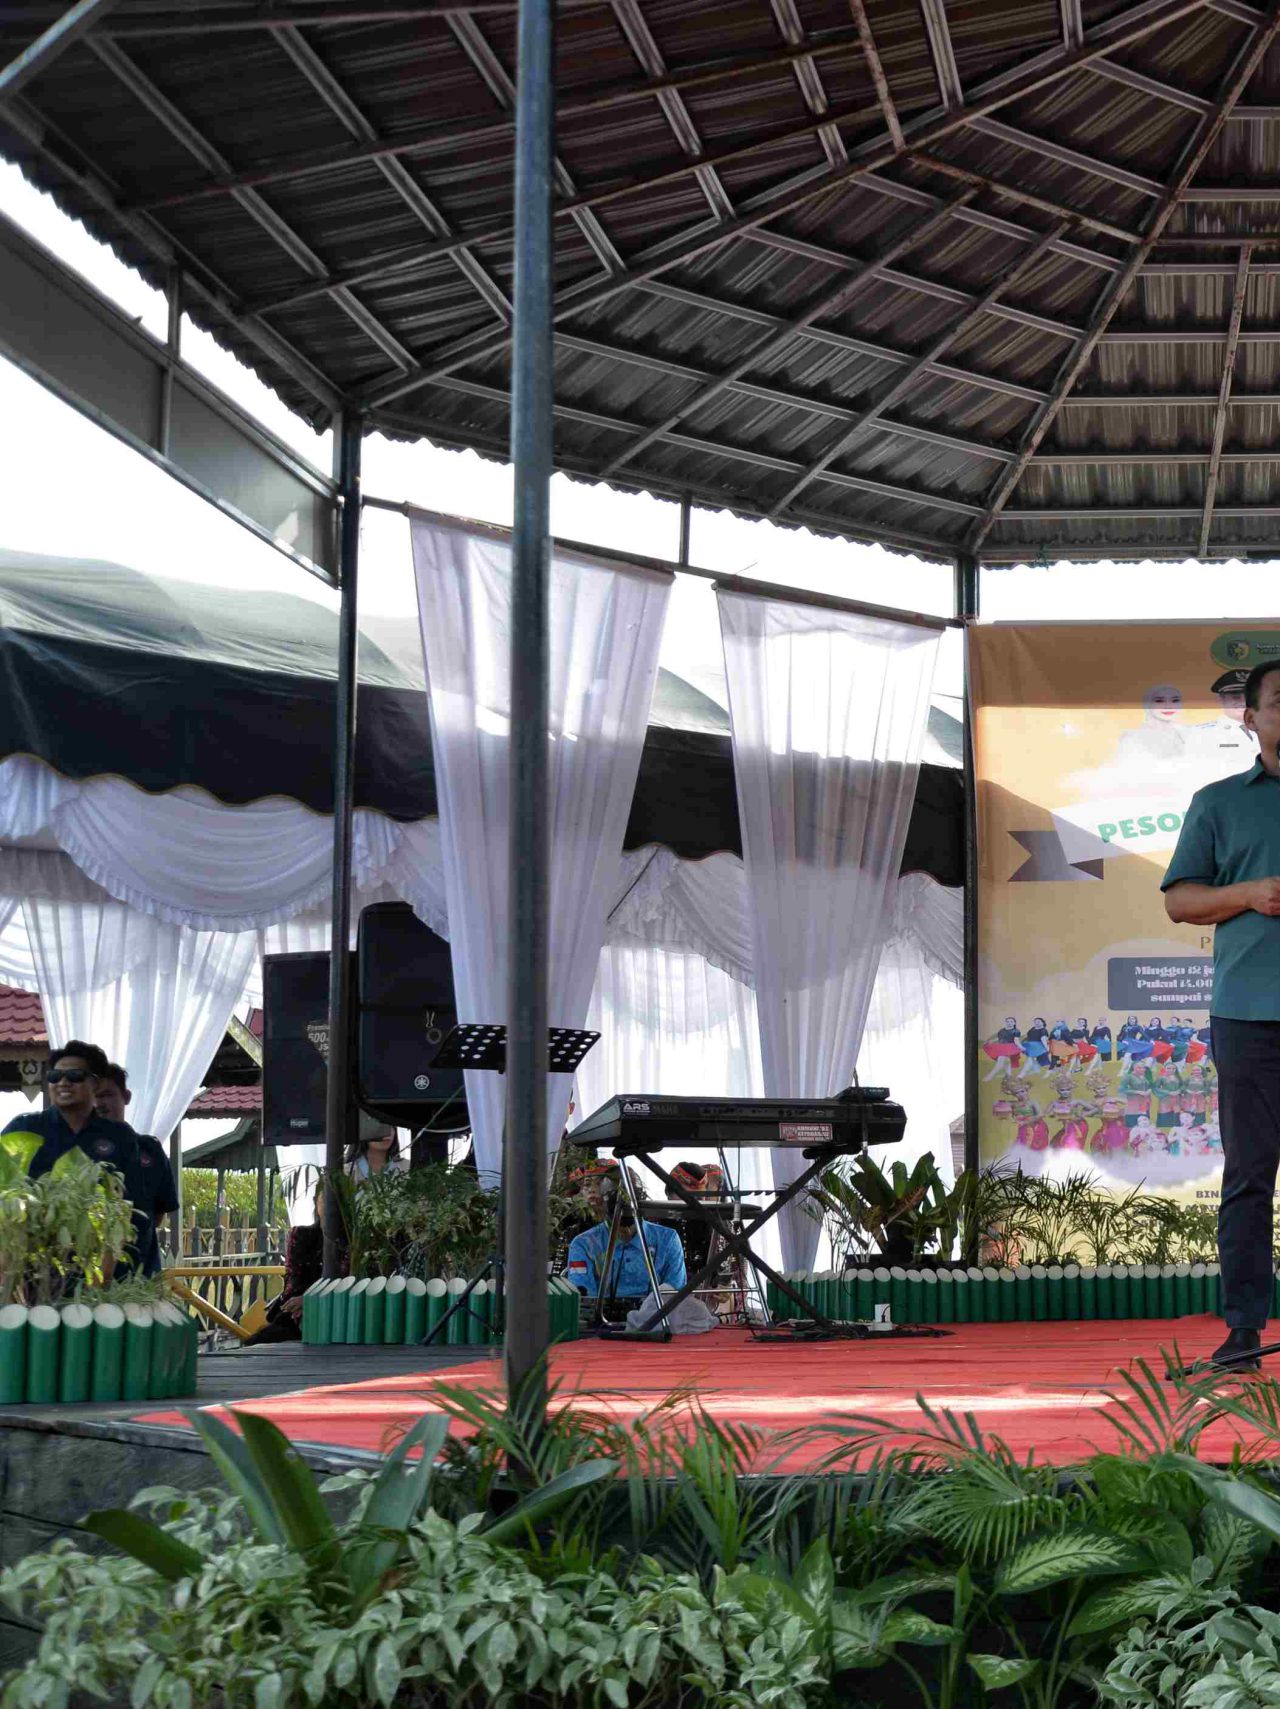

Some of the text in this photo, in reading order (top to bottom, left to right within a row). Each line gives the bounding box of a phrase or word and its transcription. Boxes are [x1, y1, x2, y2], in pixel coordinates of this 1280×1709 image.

[1098, 811, 1186, 843] PESO
[1135, 966, 1186, 977] Minggu
[1137, 980, 1177, 988] Pukul
[1150, 992, 1202, 1003] sampai
[623, 1103, 650, 1111] ARS
[1196, 1190, 1220, 1199] BIN
